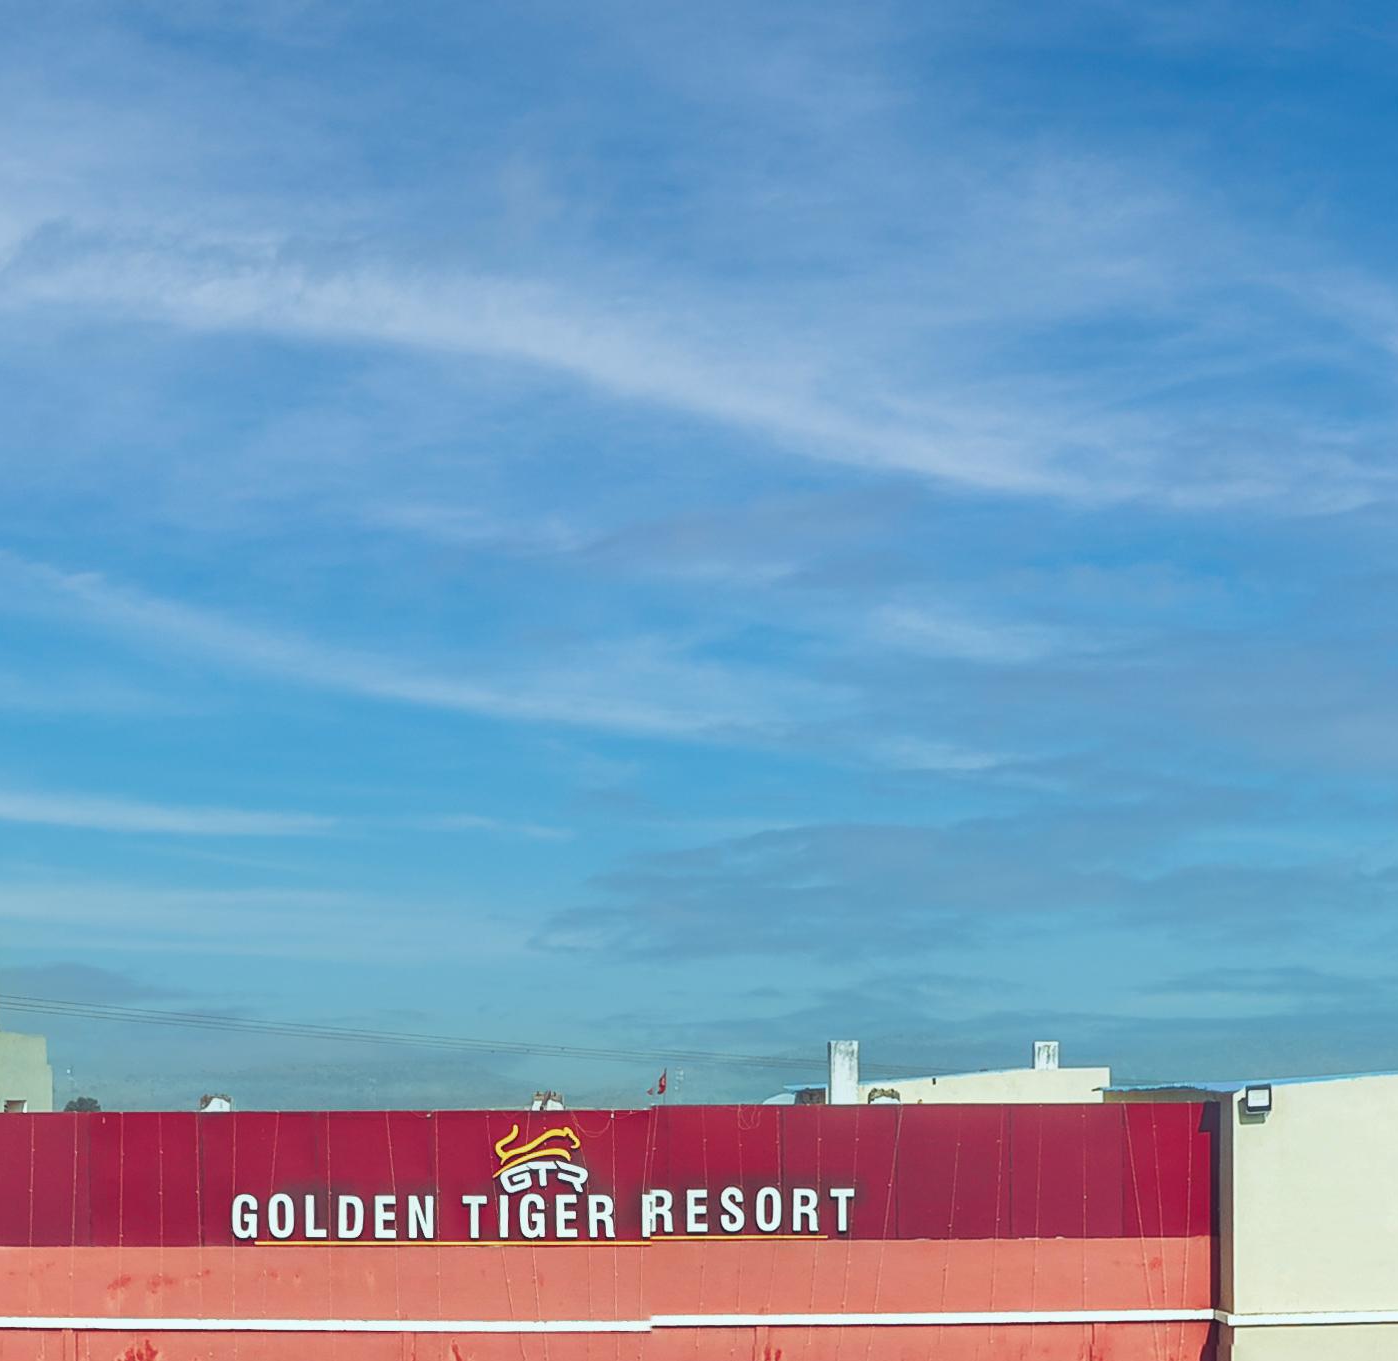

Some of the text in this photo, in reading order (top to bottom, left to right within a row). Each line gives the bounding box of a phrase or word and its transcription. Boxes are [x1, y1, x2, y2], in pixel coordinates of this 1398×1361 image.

[500, 1160, 588, 1194] GTR
[231, 1187, 857, 1239] GOLDEN TIGER RESORT
